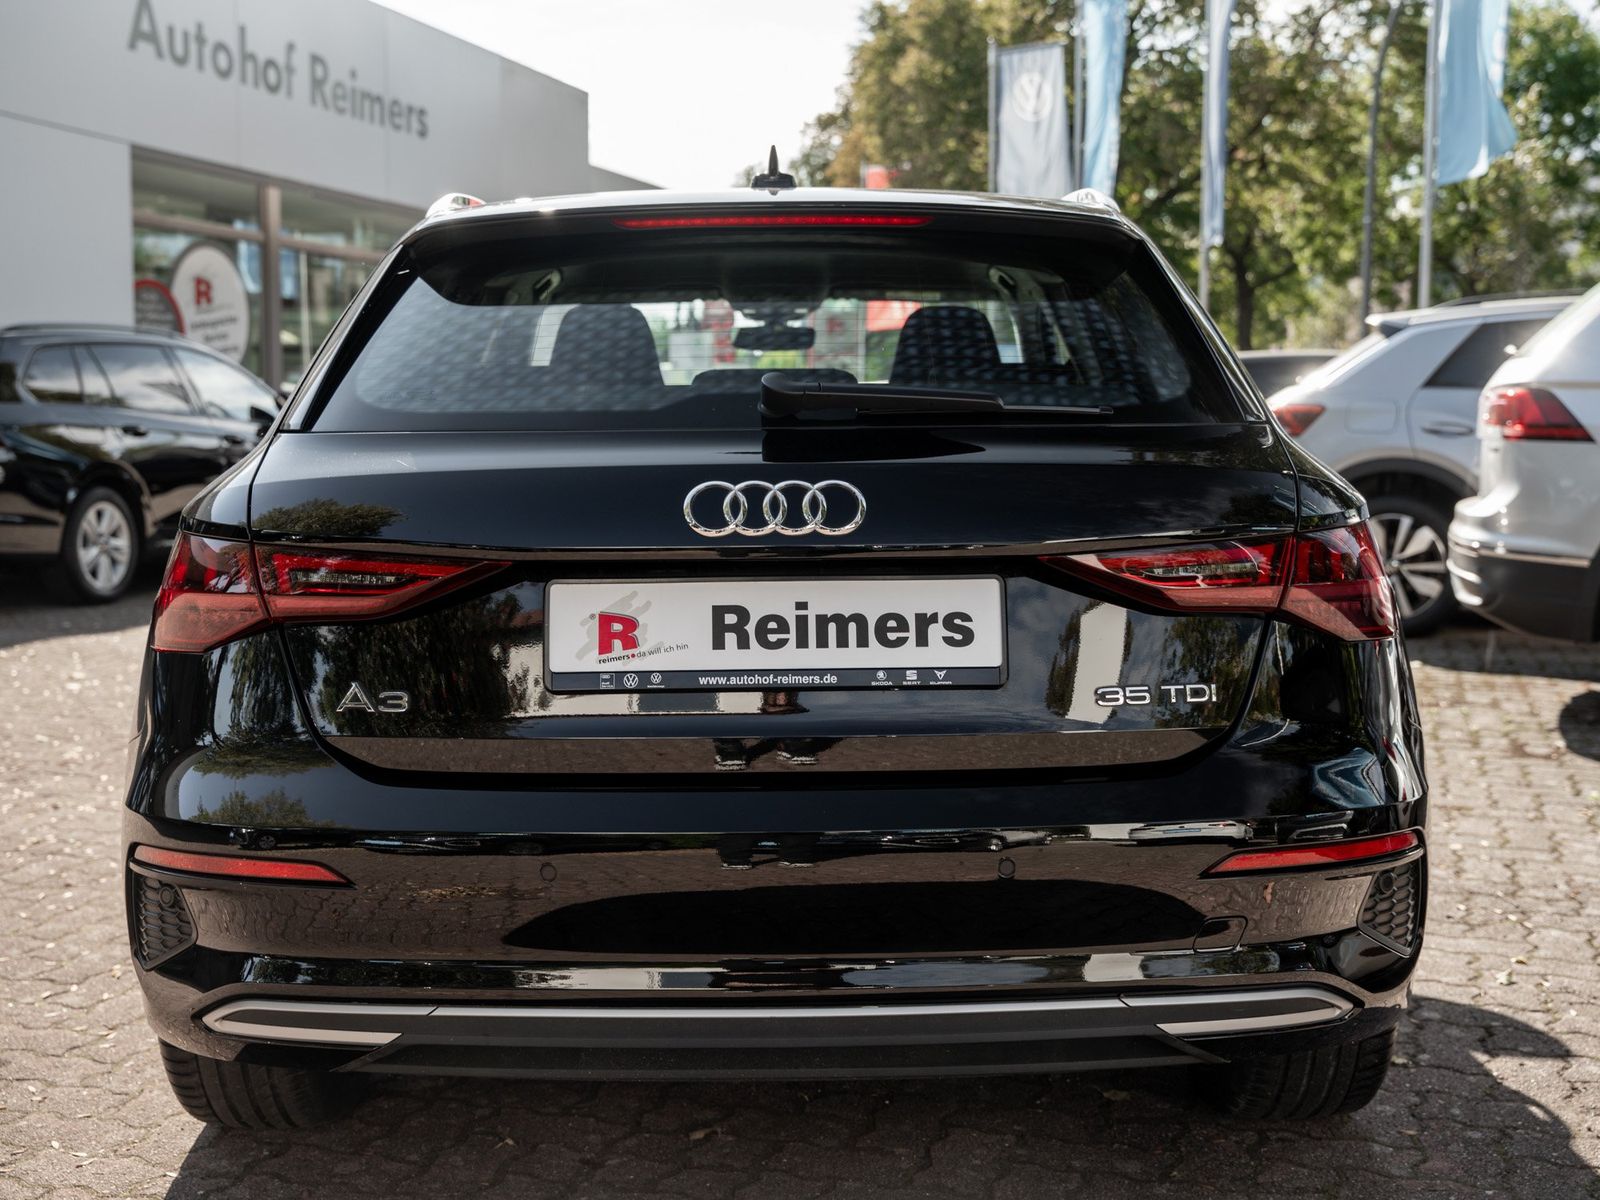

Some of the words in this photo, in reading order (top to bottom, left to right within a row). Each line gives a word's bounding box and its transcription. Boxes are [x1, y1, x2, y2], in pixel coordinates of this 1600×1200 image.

[128, 0, 296, 99] Autohof
[309, 52, 429, 139] Reimers
[598, 611, 640, 655] R
[712, 601, 975, 651] Reimers
[598, 654, 630, 664] reimers
[648, 646, 661, 657] will
[663, 644, 674, 653] ich
[676, 642, 689, 651] hin
[699, 673, 837, 687] www.autohof-reimers.de
[1095, 686, 1151, 706] 35
[1160, 683, 1217, 703] TDI
[336, 682, 408, 712] A3
